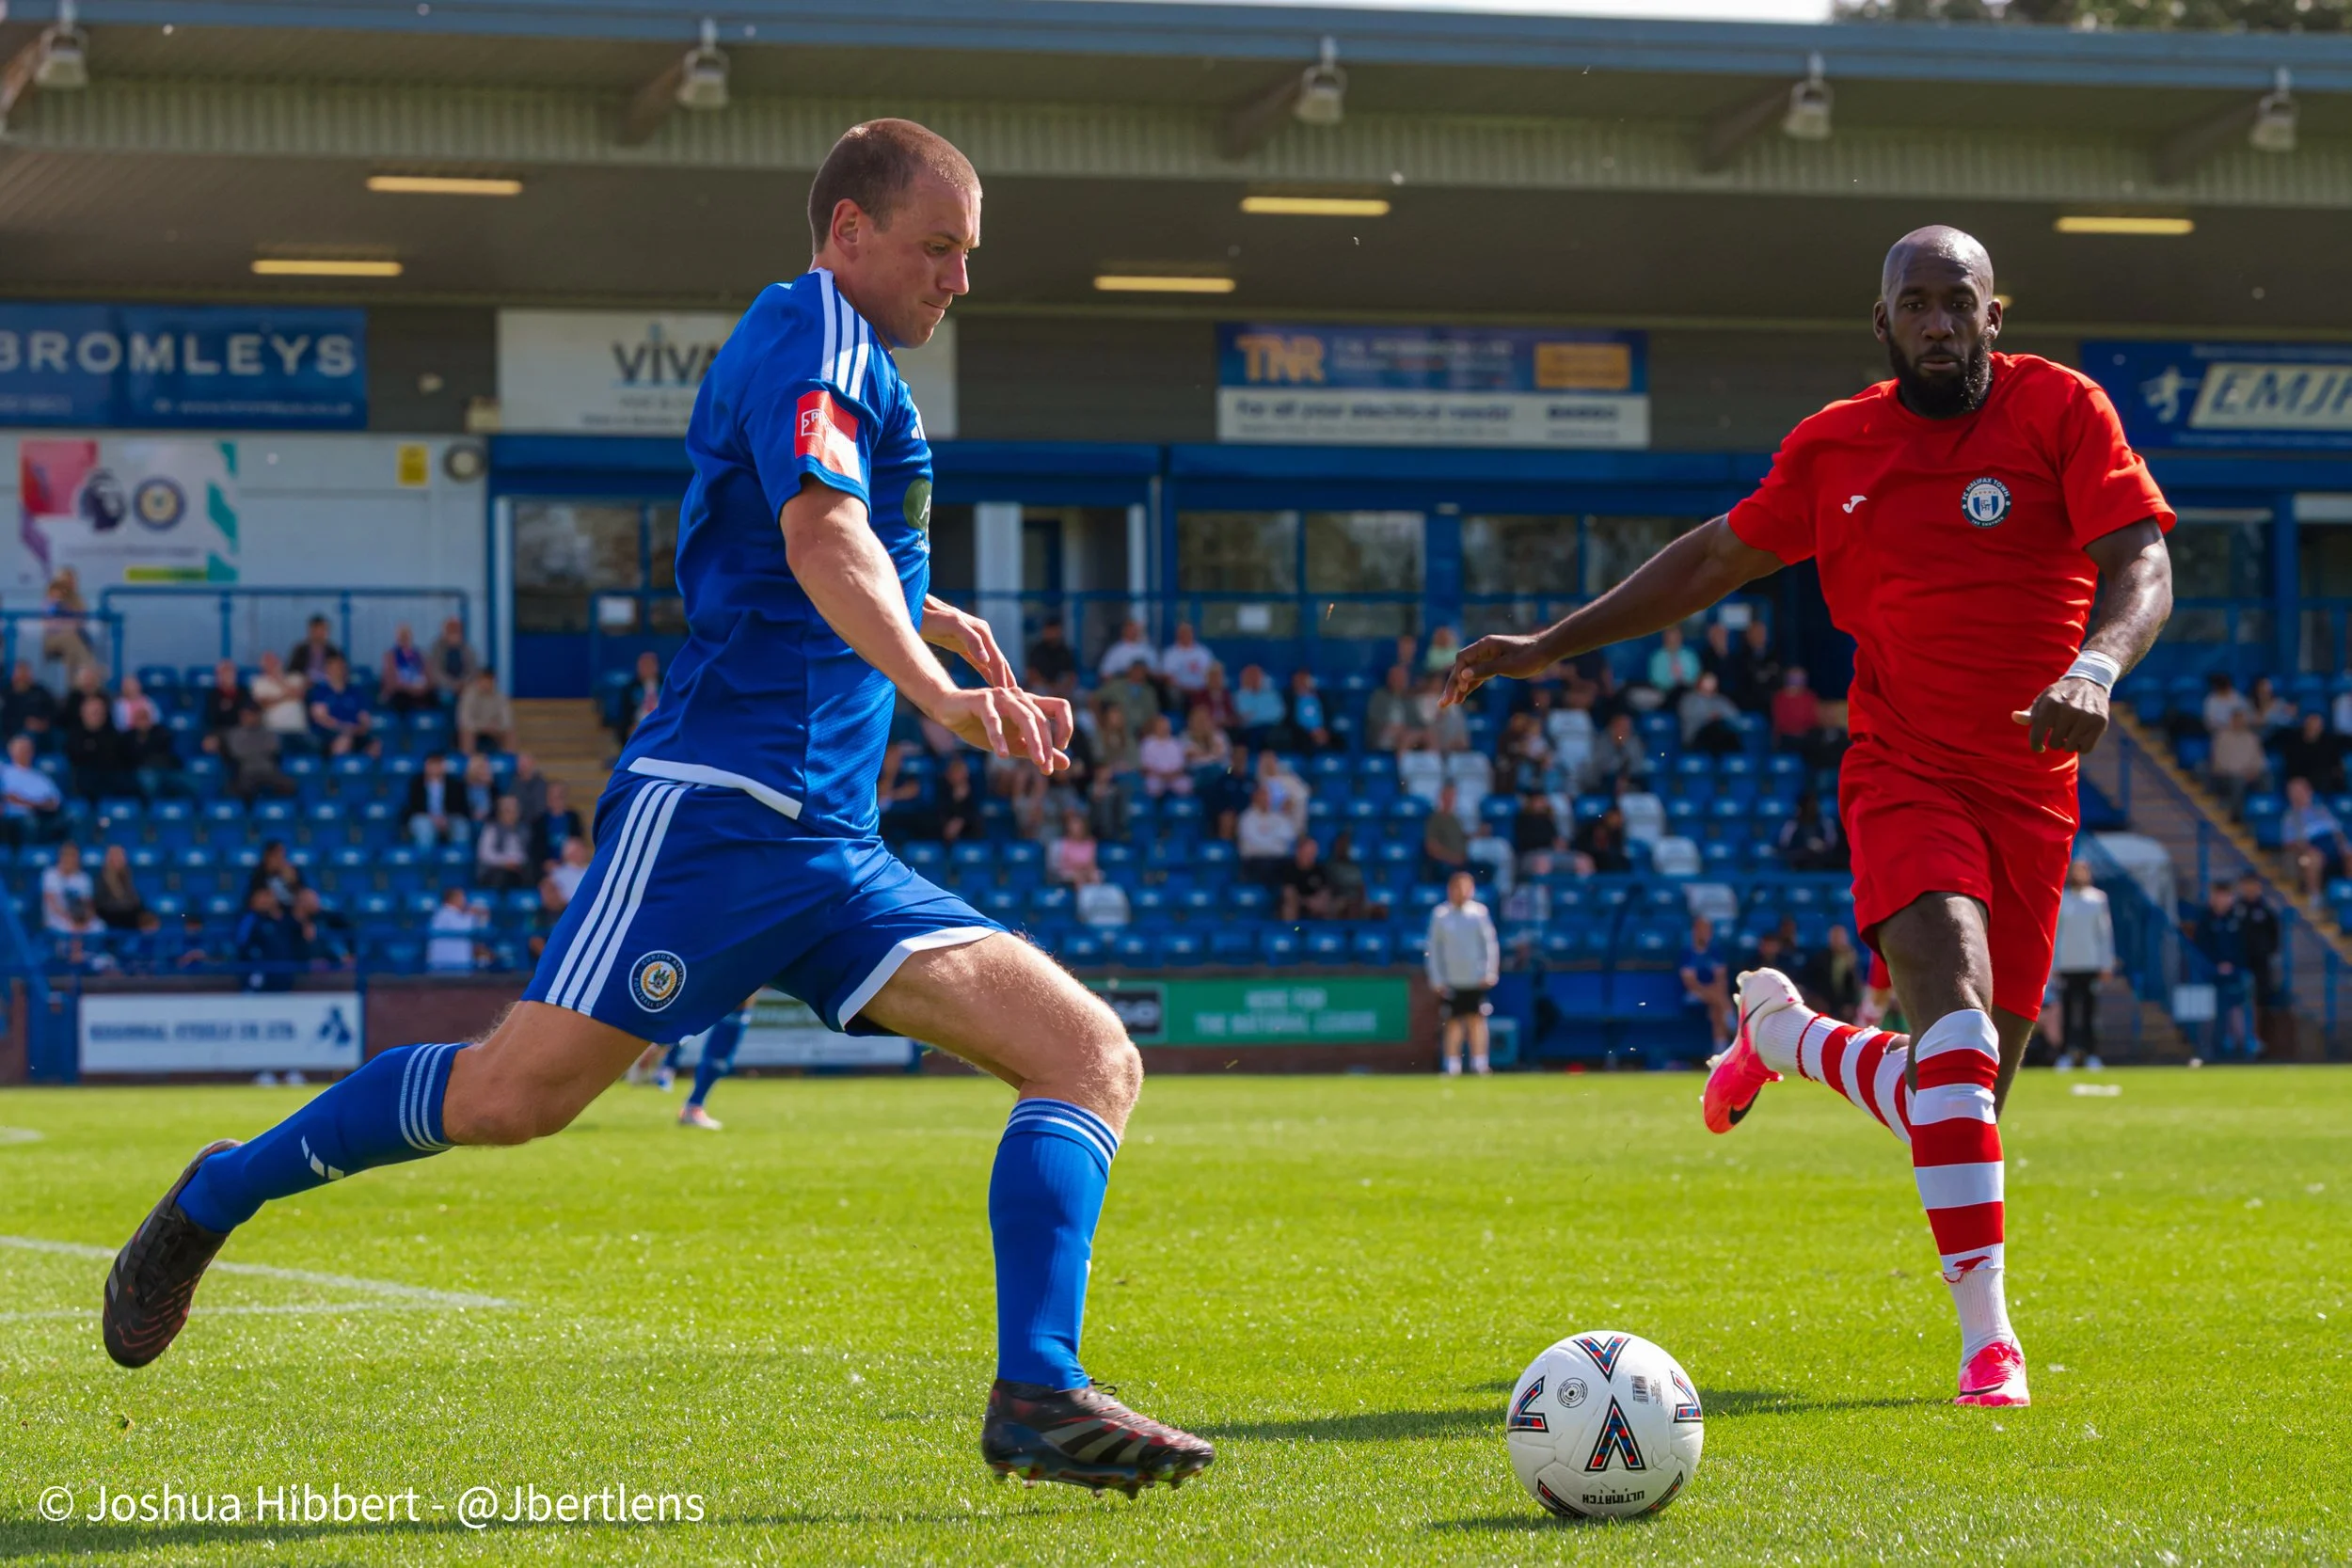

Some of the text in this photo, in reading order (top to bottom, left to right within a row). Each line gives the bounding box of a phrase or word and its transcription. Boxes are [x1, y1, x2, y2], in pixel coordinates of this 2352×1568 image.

[1237, 334, 1325, 383] TNR
[1274, 400, 1295, 419] all
[1966, 478, 1993, 493] HALIFAX
[1993, 479, 2010, 498] TOWN
[642, 954, 684, 987] CURZON ASHTON
[633, 977, 655, 1008] FOOTBALL
[1581, 1489, 1645, 1505] ULTIMATCH
